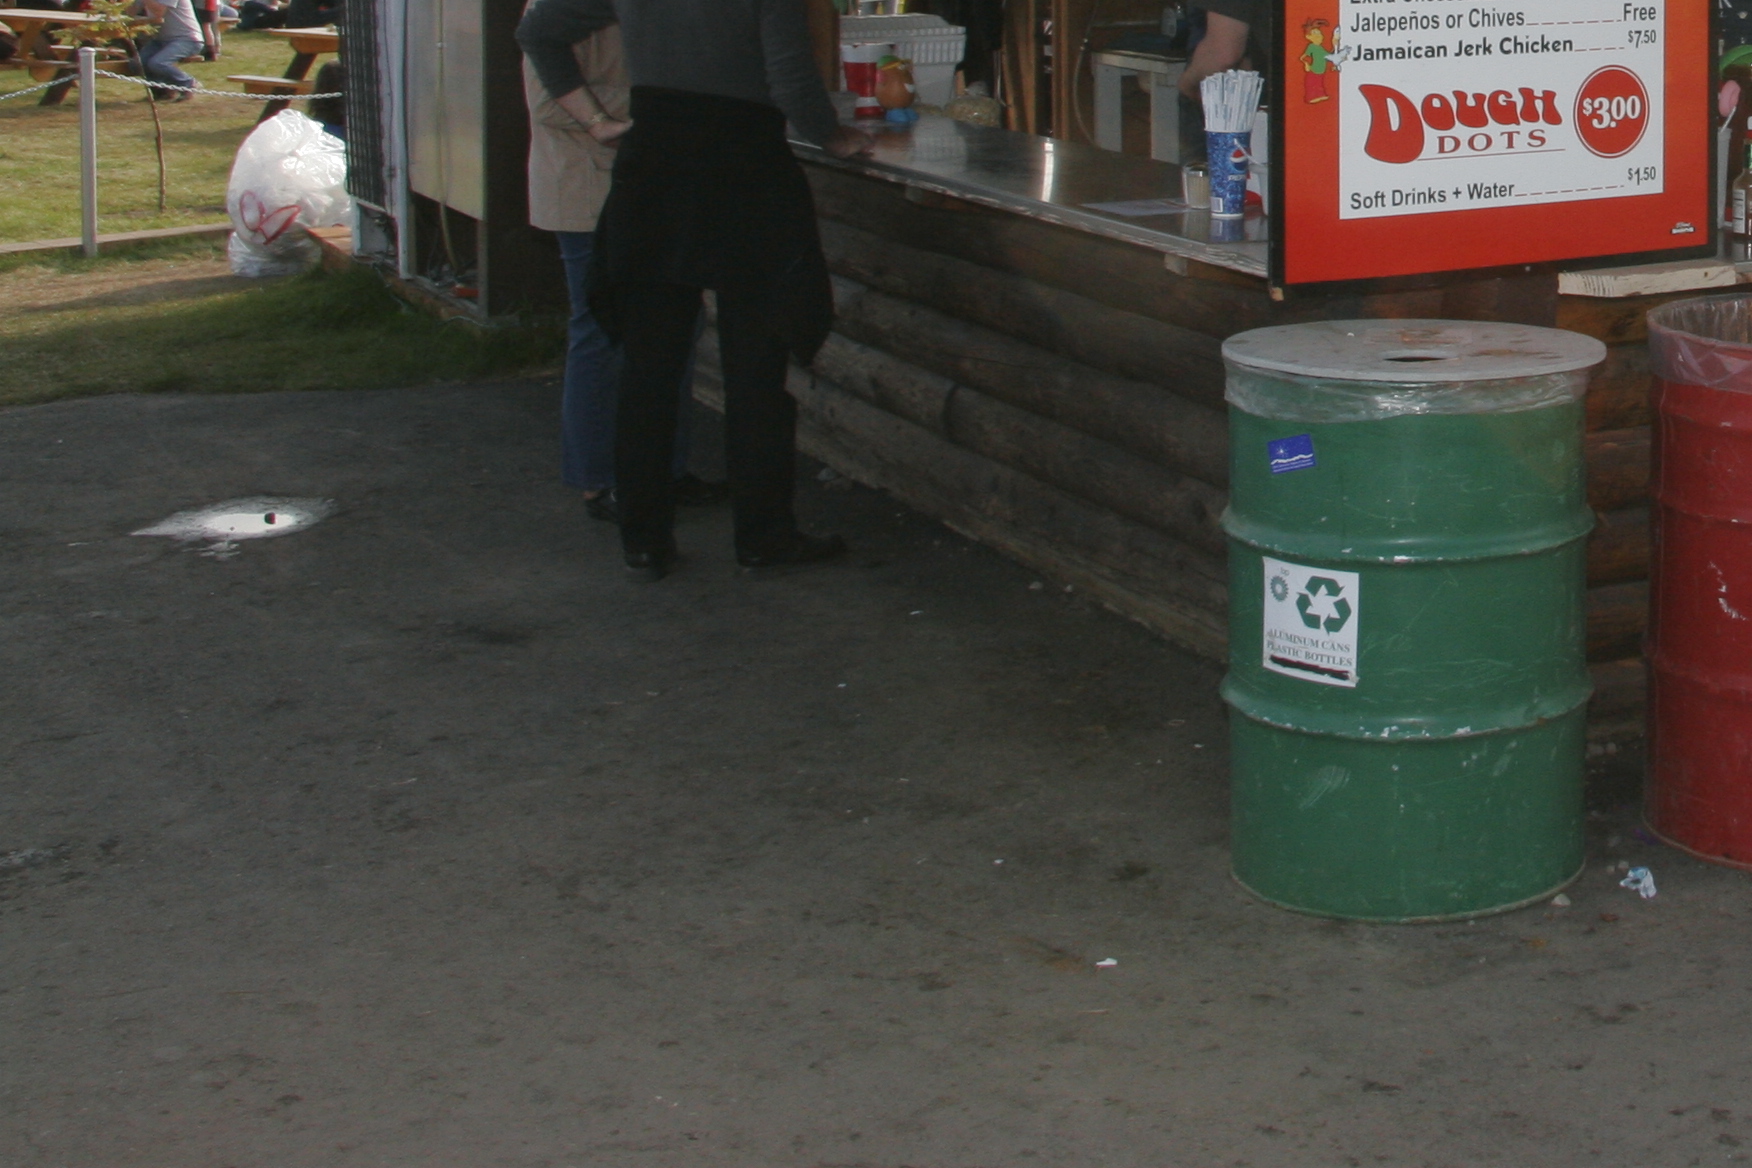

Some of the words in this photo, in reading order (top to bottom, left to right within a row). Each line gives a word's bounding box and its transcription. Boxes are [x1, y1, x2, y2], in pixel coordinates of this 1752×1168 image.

[1350, 9, 1440, 35] Jalepeños
[1446, 13, 1463, 29] or
[1467, 8, 1525, 27] Chives
[1622, 3, 1657, 23] Free
[1352, 41, 1448, 62] Jamaican
[1454, 39, 1493, 58] Jerk
[1499, 35, 1573, 55] Chicken
[1627, 29, 1657, 48] $7.50
[1358, 84, 1562, 164] DOUGH
[1582, 95, 1641, 129] $3.00
[1436, 128, 1547, 155] DOTS
[1350, 190, 1386, 211] Soft
[1392, 187, 1446, 208] Drinks
[1452, 188, 1462, 200] +
[1467, 183, 1514, 202] Water
[1627, 166, 1657, 184] $1.50
[1266, 629, 1320, 649] ALUMINUM
[1321, 640, 1351, 653] CANS
[1266, 640, 1302, 658] PLASTIC
[1304, 650, 1354, 666] BOTTLES
